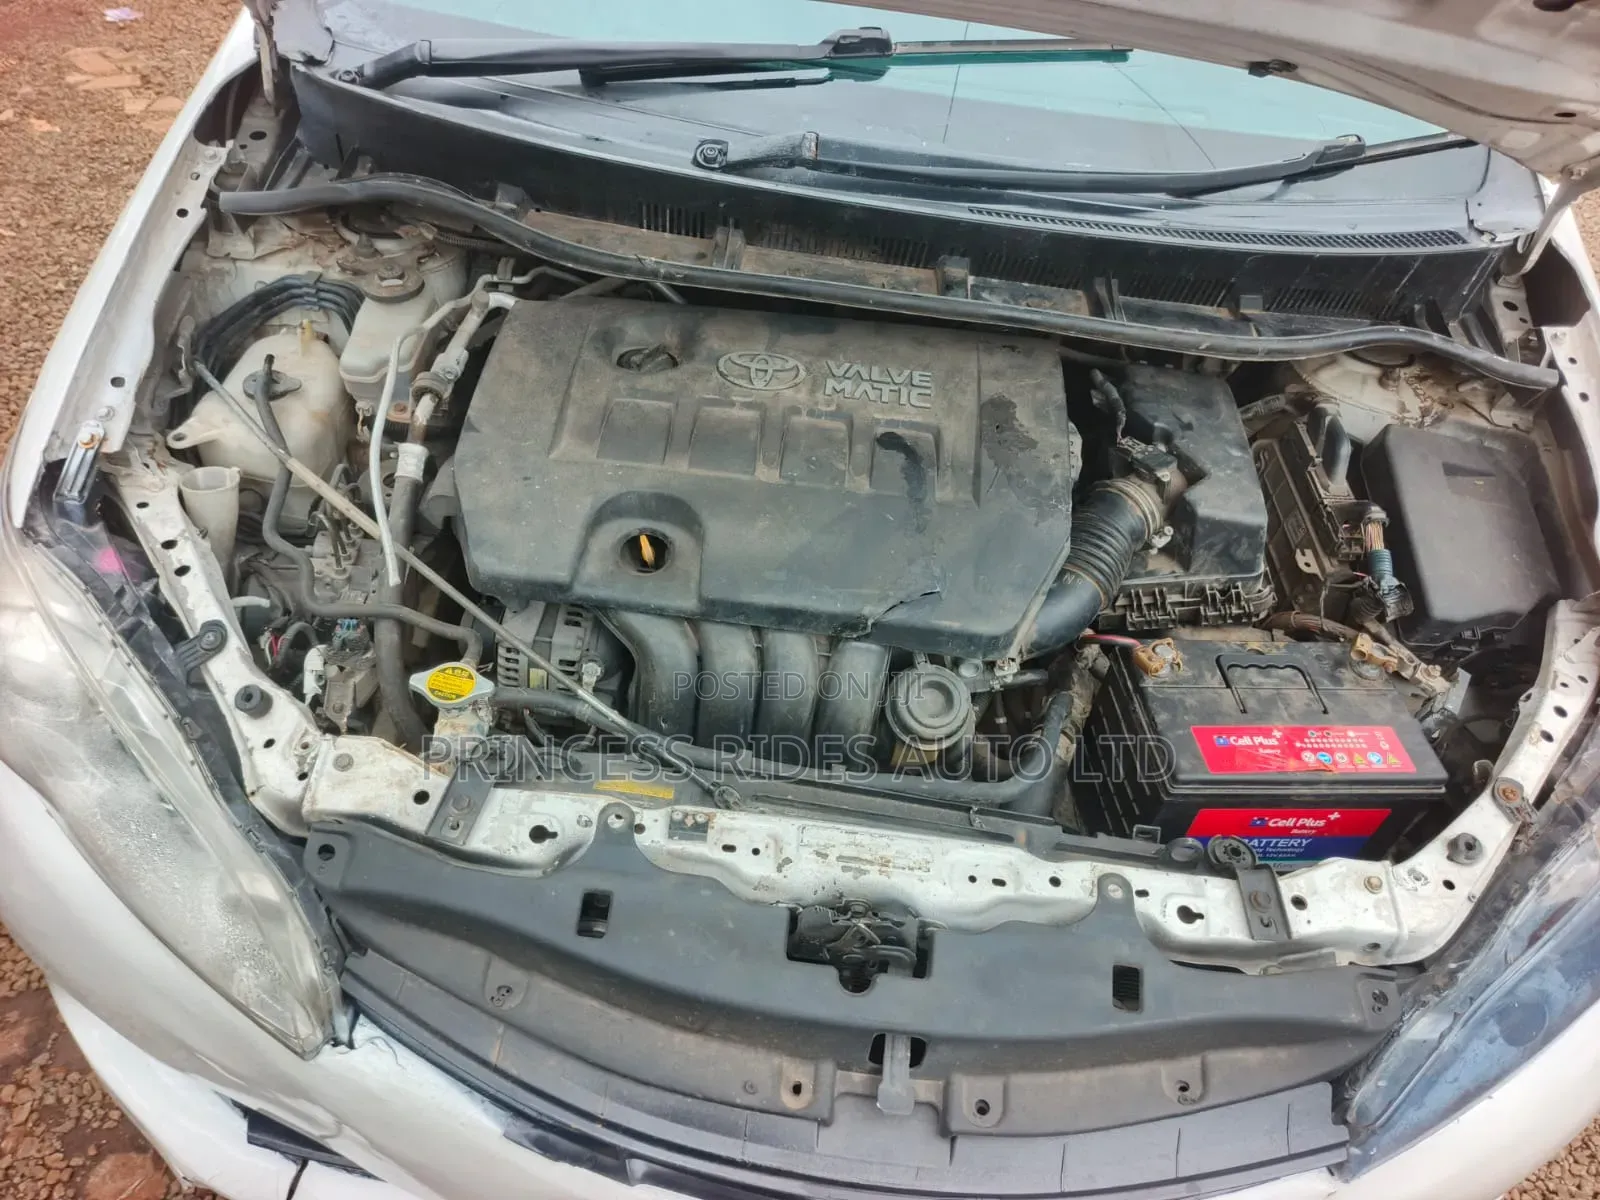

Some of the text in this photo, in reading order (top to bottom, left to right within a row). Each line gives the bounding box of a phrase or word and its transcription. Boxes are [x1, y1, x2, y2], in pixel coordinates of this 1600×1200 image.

[825, 360, 933, 388] VALVE
[824, 379, 933, 409] MATIC
[1229, 735, 1253, 746] Cell
[1268, 817, 1327, 828] Cell Plus
